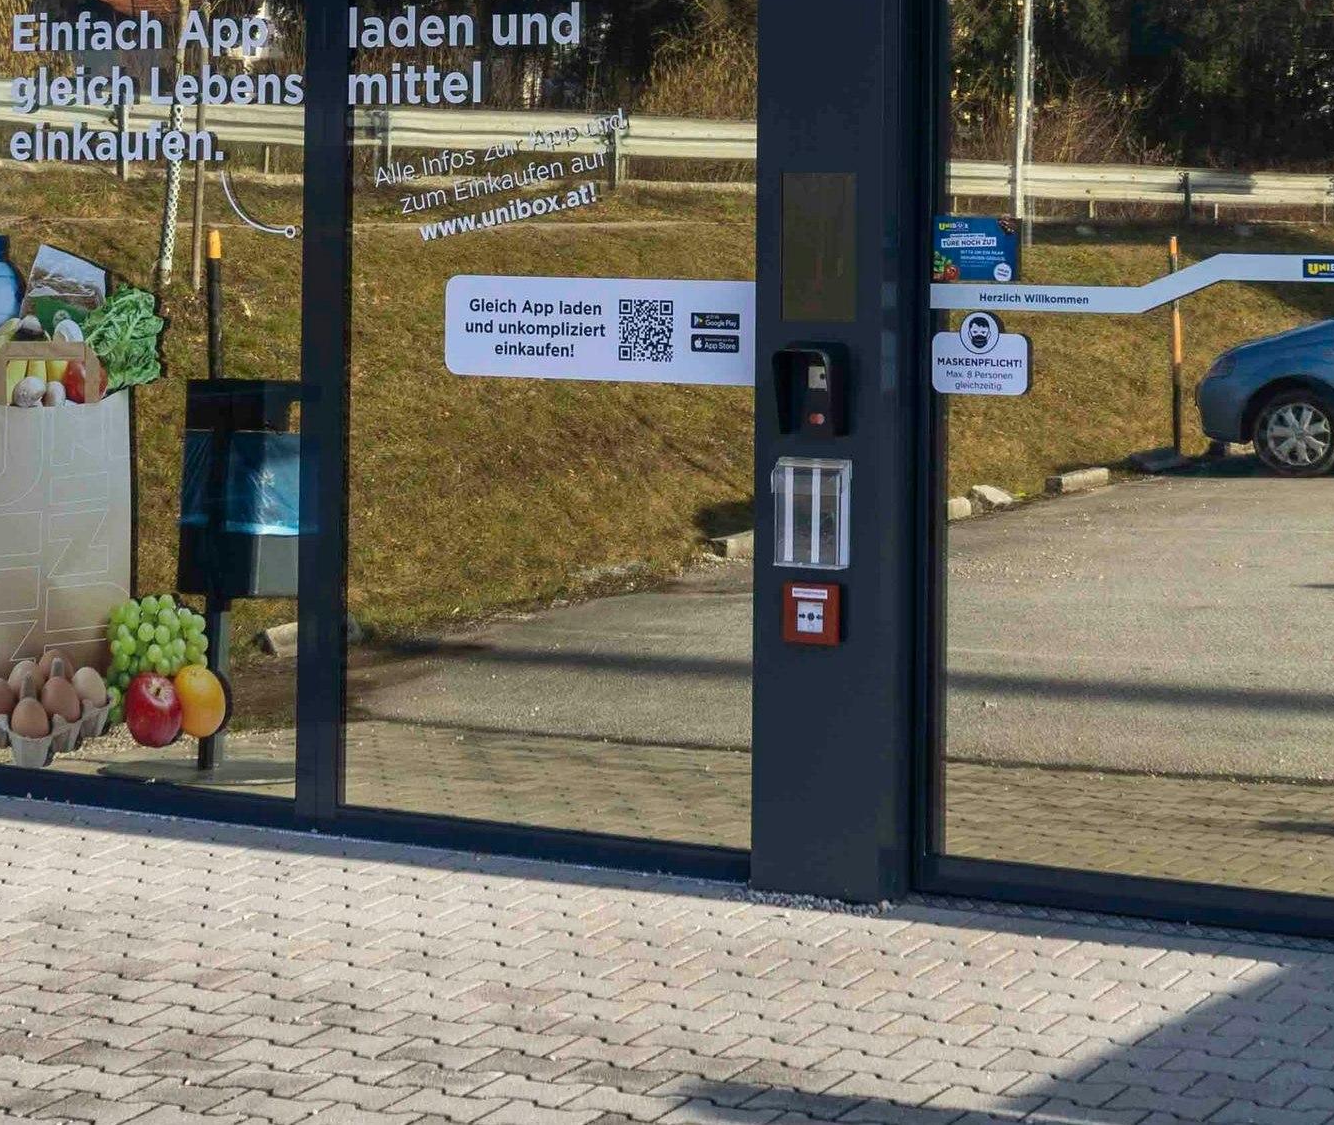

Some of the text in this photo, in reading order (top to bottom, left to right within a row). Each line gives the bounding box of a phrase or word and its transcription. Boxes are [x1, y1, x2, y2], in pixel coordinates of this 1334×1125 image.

[12, 1, 580, 57] Einfach App laden und
[11, 66, 135, 114] gleich
[10, 121, 224, 162] einkaufen.
[375, 159, 417, 188] Alle
[422, 149, 477, 177] Infos
[483, 139, 524, 163] zur
[584, 107, 627, 137] und
[400, 147, 608, 215] zum Einkaufen auf
[419, 182, 598, 243] www.unibox.at!
[469, 298, 602, 318] Gleich App laden
[979, 293, 1089, 305] Herzlich Willkommen
[466, 320, 606, 340] und unkompliziert
[494, 342, 575, 358] einkaufen!
[704, 342, 737, 351] App Store
[937, 357, 1023, 368] MASKENPFLICHT!
[974, 371, 1013, 380] Personen
